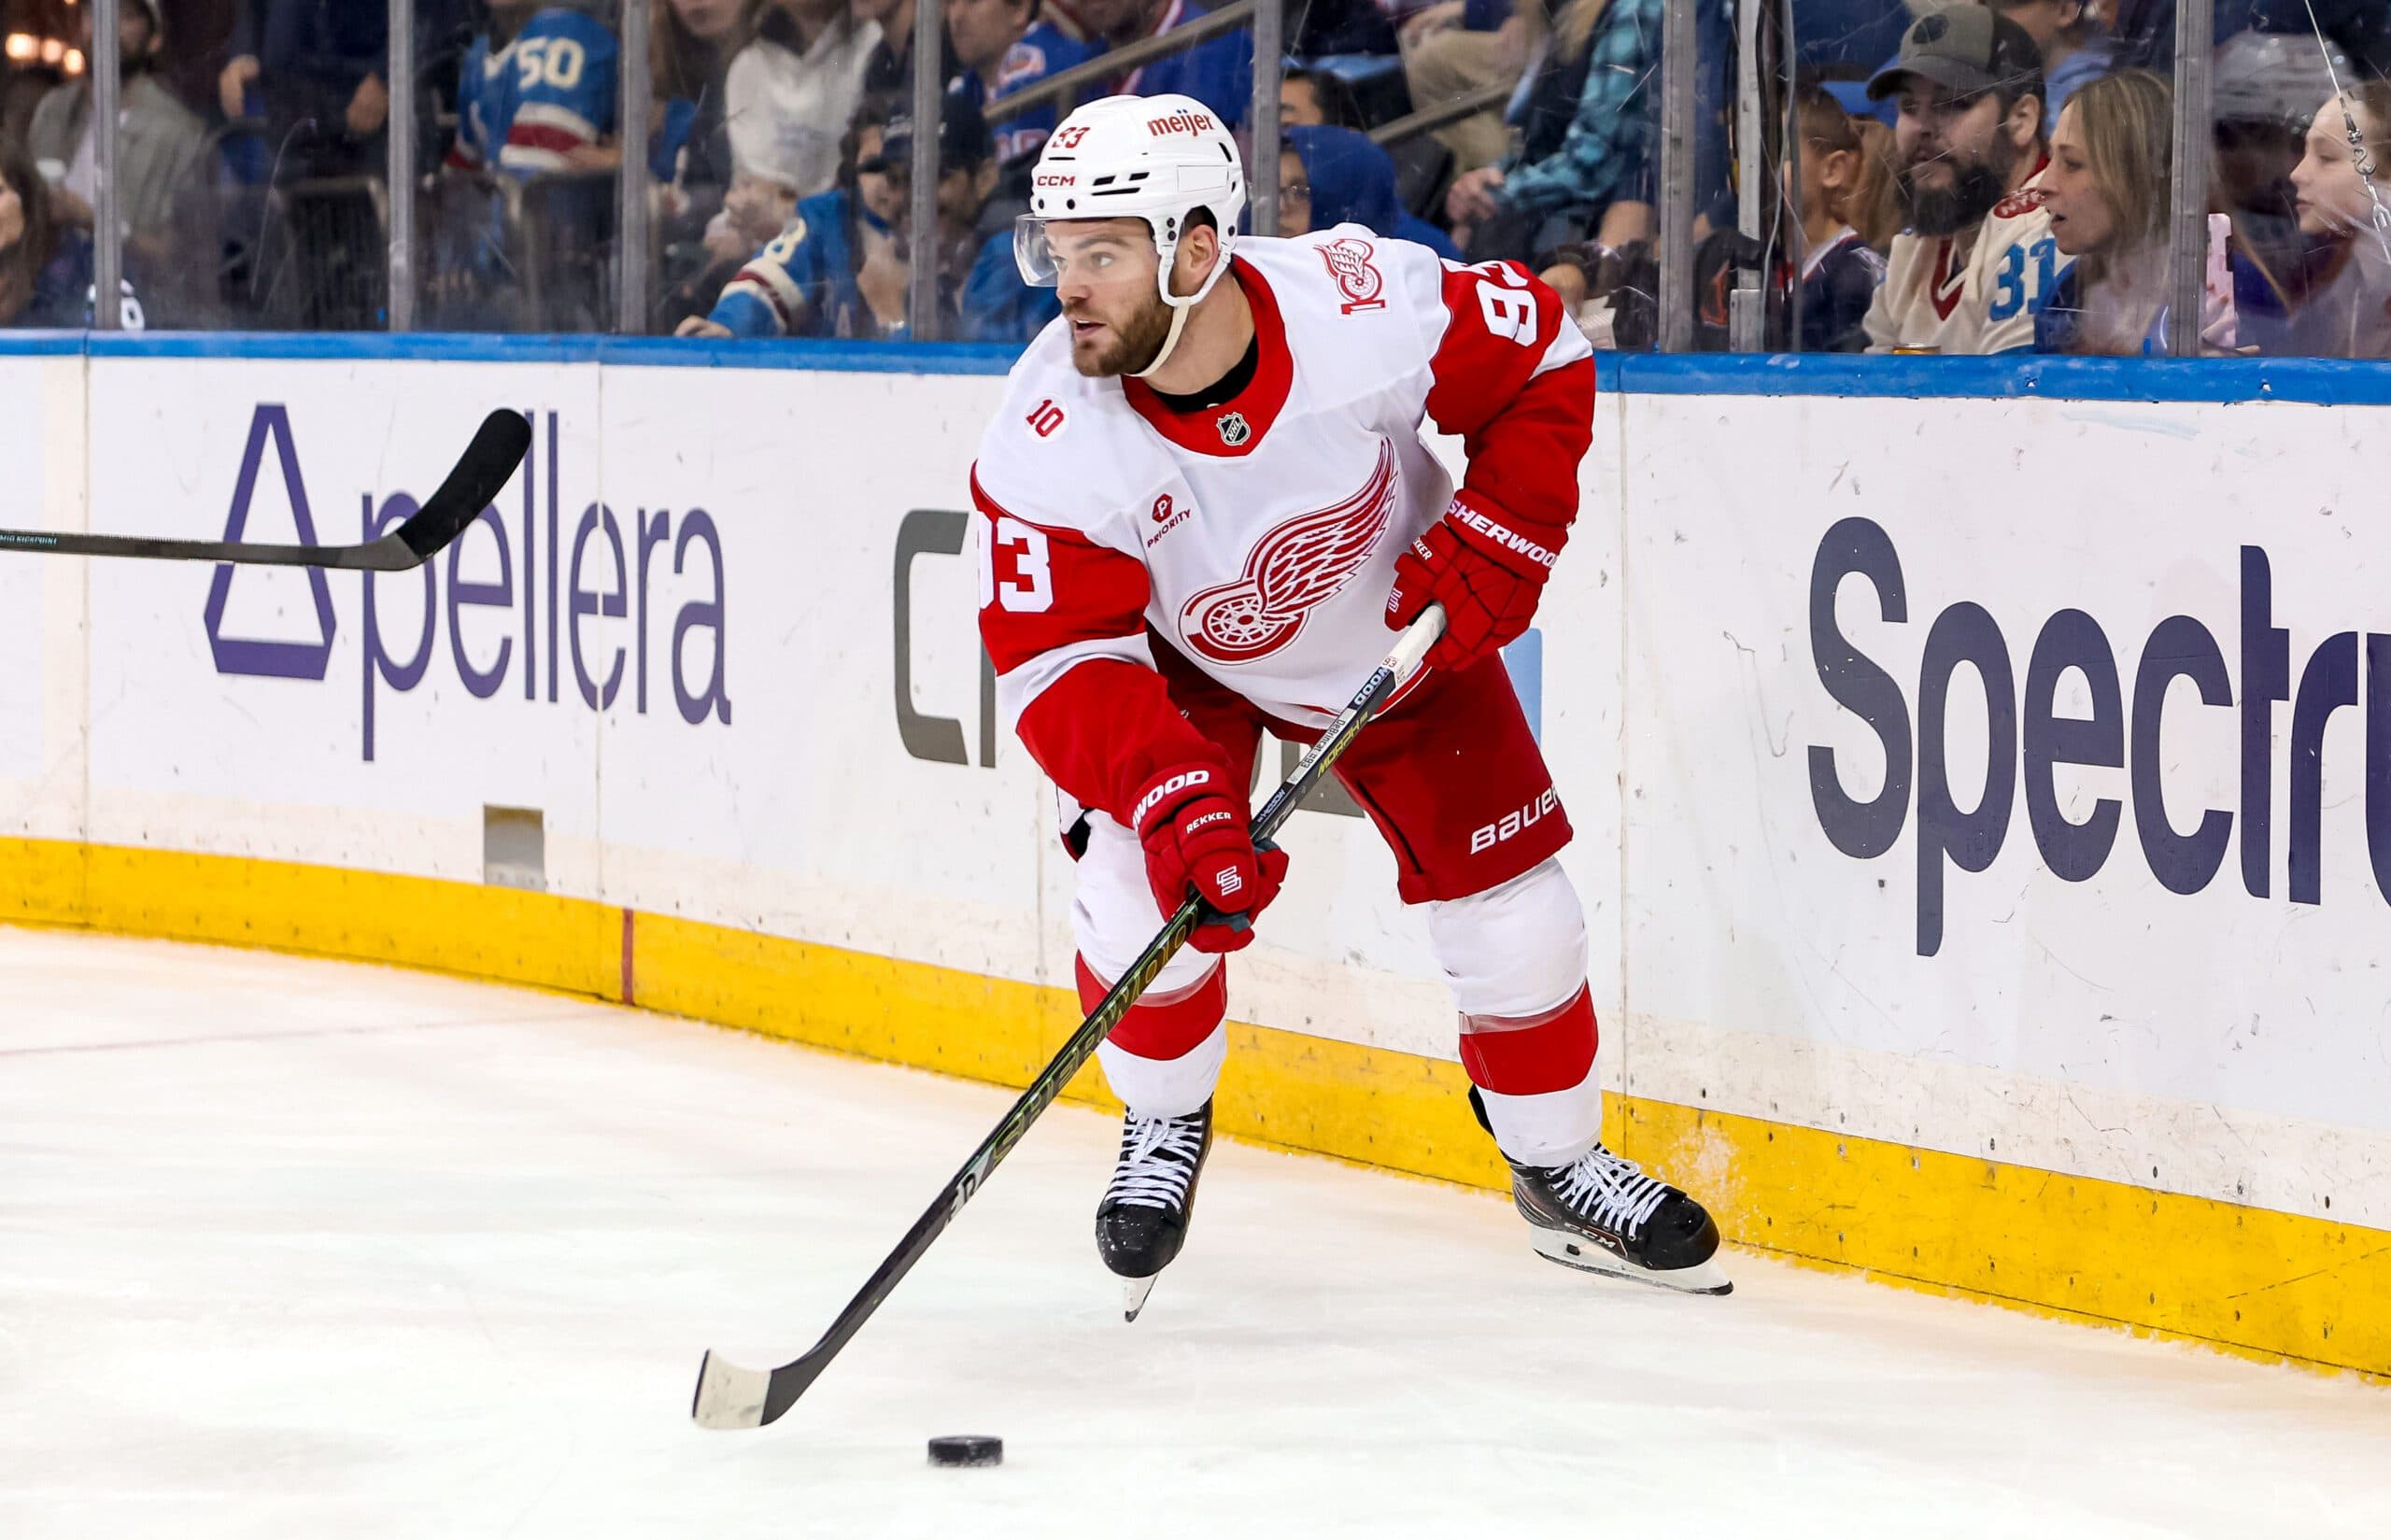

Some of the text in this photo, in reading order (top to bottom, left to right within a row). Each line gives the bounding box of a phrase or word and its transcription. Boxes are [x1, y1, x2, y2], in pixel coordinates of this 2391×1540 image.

[517, 35, 584, 91] 50
[1147, 108, 1215, 137] meijer
[1037, 176, 1075, 186] CCM
[1989, 237, 2057, 321] 31
[1026, 399, 1065, 438] 10
[1147, 508, 1191, 548] PRIORITY
[1449, 500, 1557, 567] SHERWOO
[1186, 812, 1231, 834] REKKER
